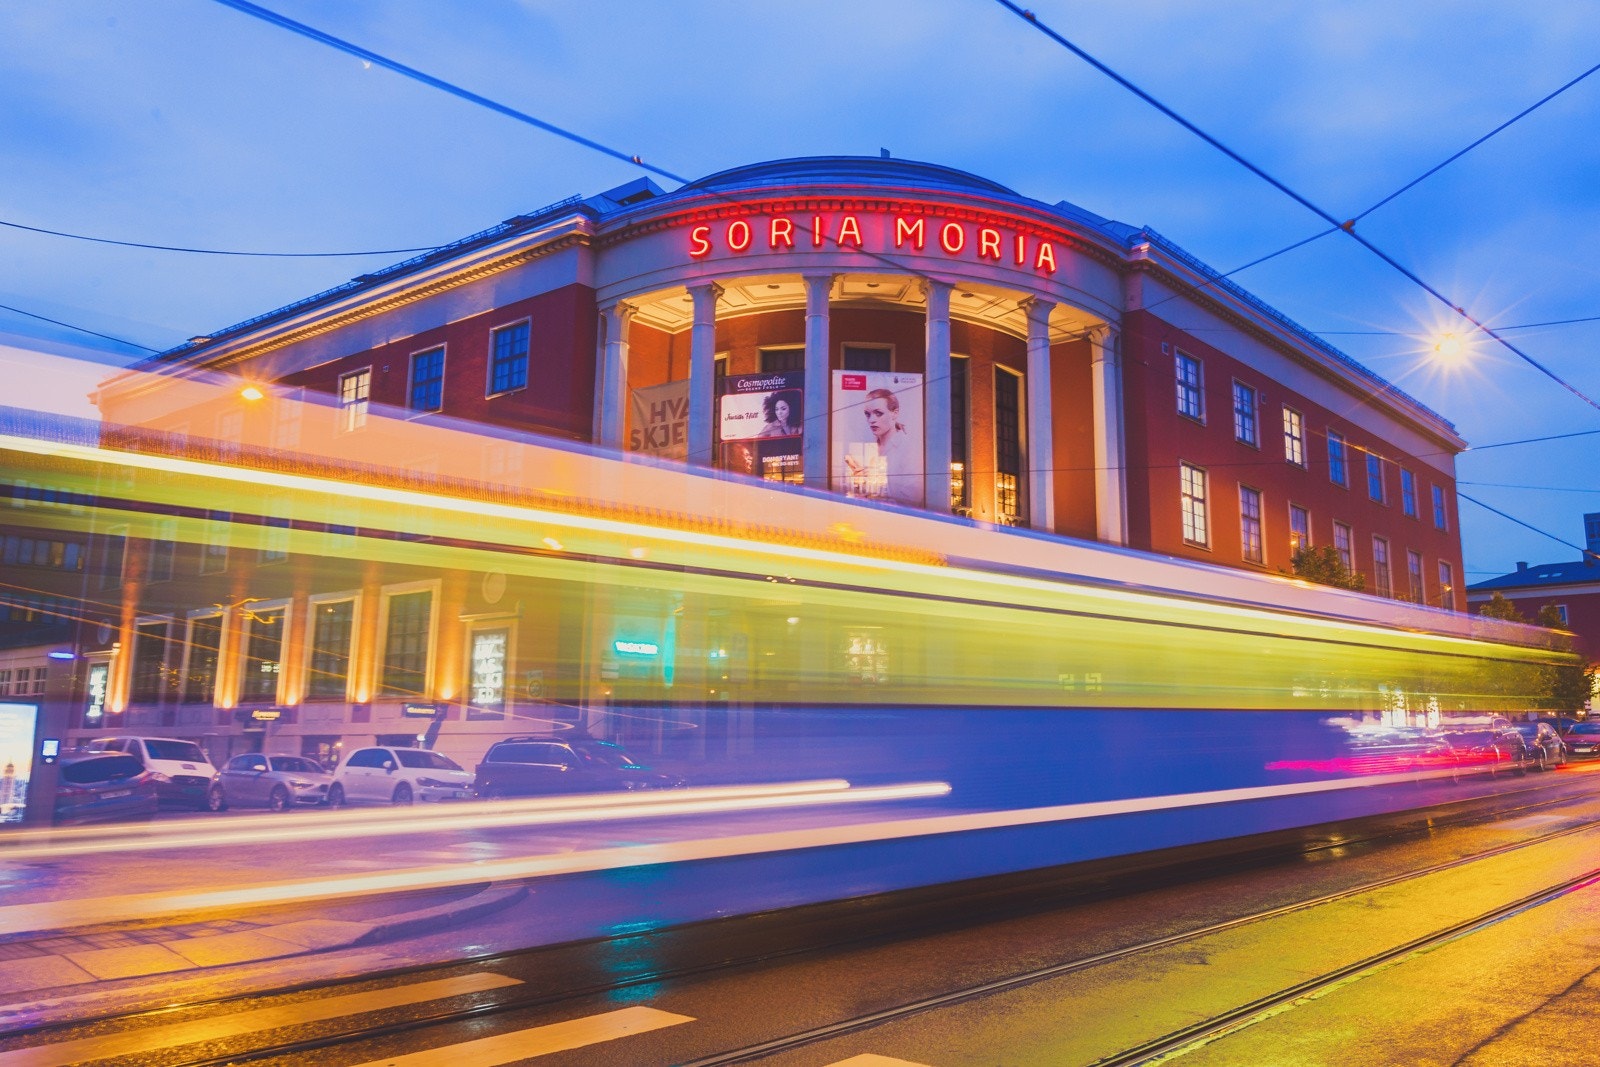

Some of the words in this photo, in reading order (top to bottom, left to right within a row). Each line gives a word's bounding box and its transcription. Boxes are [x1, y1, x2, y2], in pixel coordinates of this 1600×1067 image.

[690, 215, 863, 258] SORIA
[895, 216, 1057, 273] MORIA
[737, 376, 786, 390] Cosmopolite
[650, 397, 689, 424] HVA
